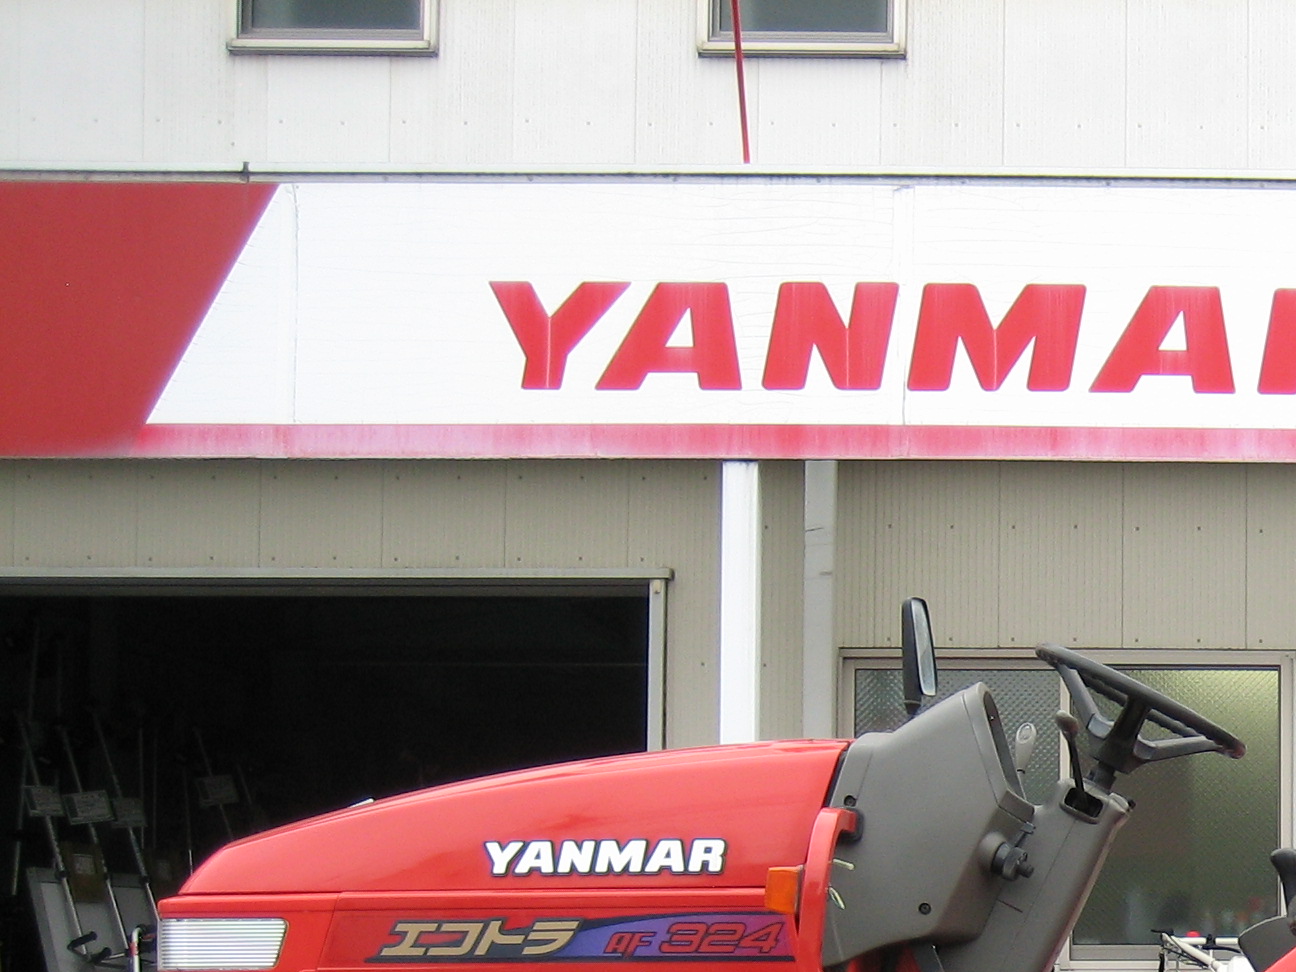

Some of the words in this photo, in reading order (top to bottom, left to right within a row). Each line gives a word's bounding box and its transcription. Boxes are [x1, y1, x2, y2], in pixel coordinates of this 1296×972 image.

[484, 838, 727, 876] YANMAR
[379, 918, 583, 957] エコトラ
[604, 930, 657, 957] AF
[658, 921, 785, 955] 324
